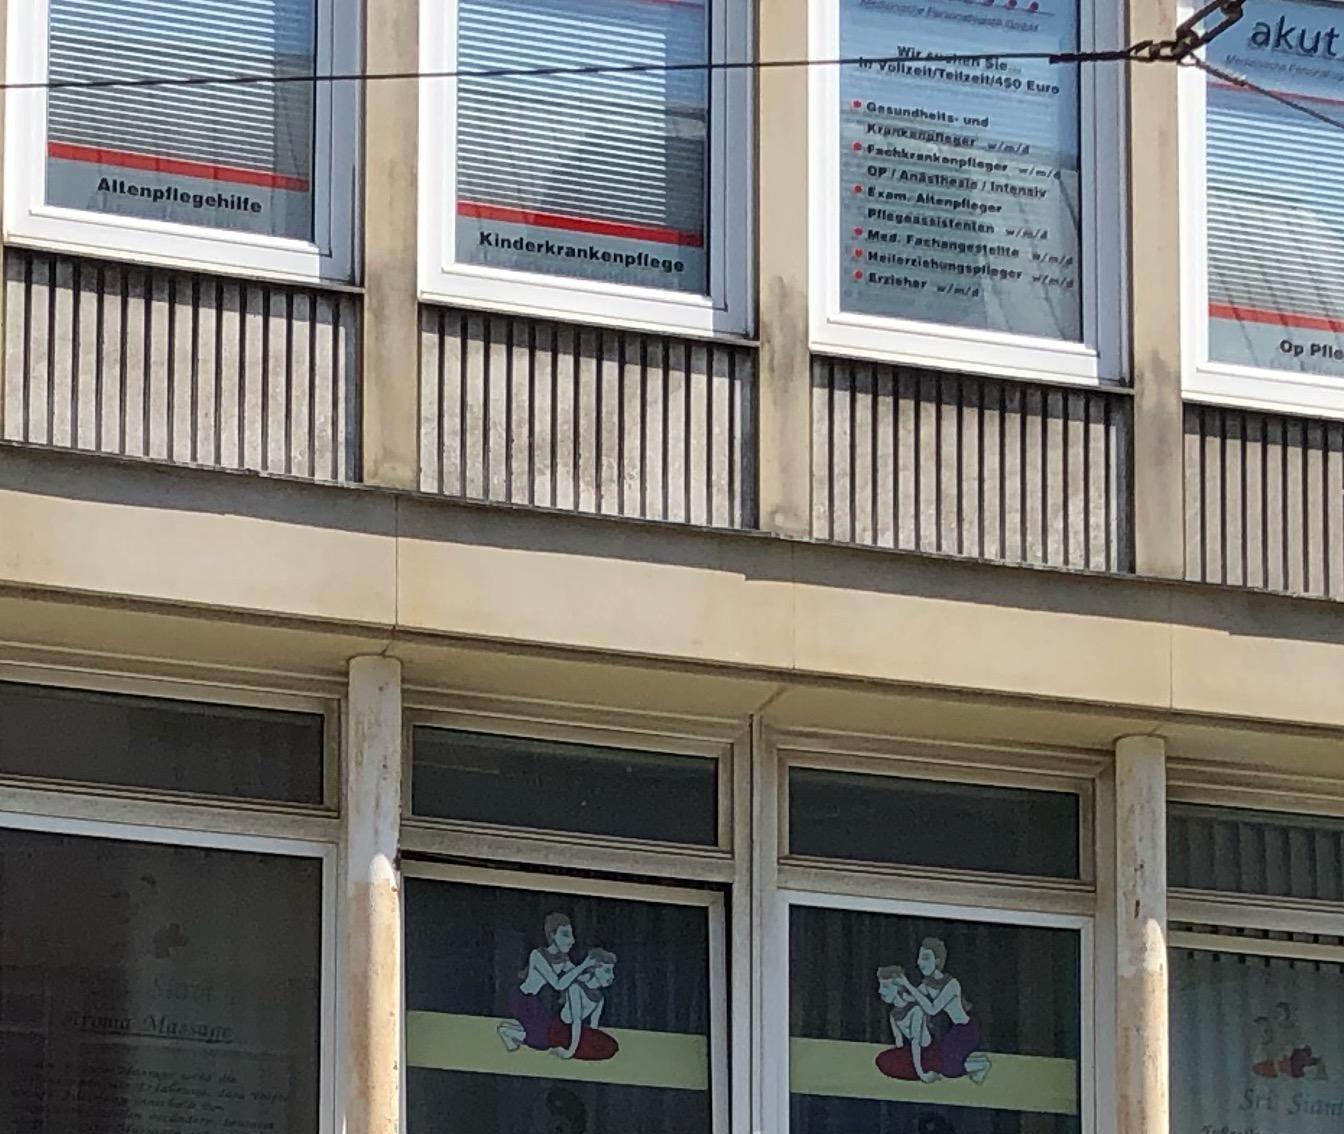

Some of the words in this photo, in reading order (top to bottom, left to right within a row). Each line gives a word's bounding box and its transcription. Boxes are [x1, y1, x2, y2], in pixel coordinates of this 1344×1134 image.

[1027, 80, 1060, 95] Euro
[963, 115, 989, 128] und
[866, 144, 1009, 173] Fachkrankenpfleger
[97, 177, 263, 214] Altenpflegehilfe
[916, 193, 1003, 215] Altenpfleger
[479, 231, 685, 273] Kinderkrankenpflege
[1280, 339, 1305, 357] Op
